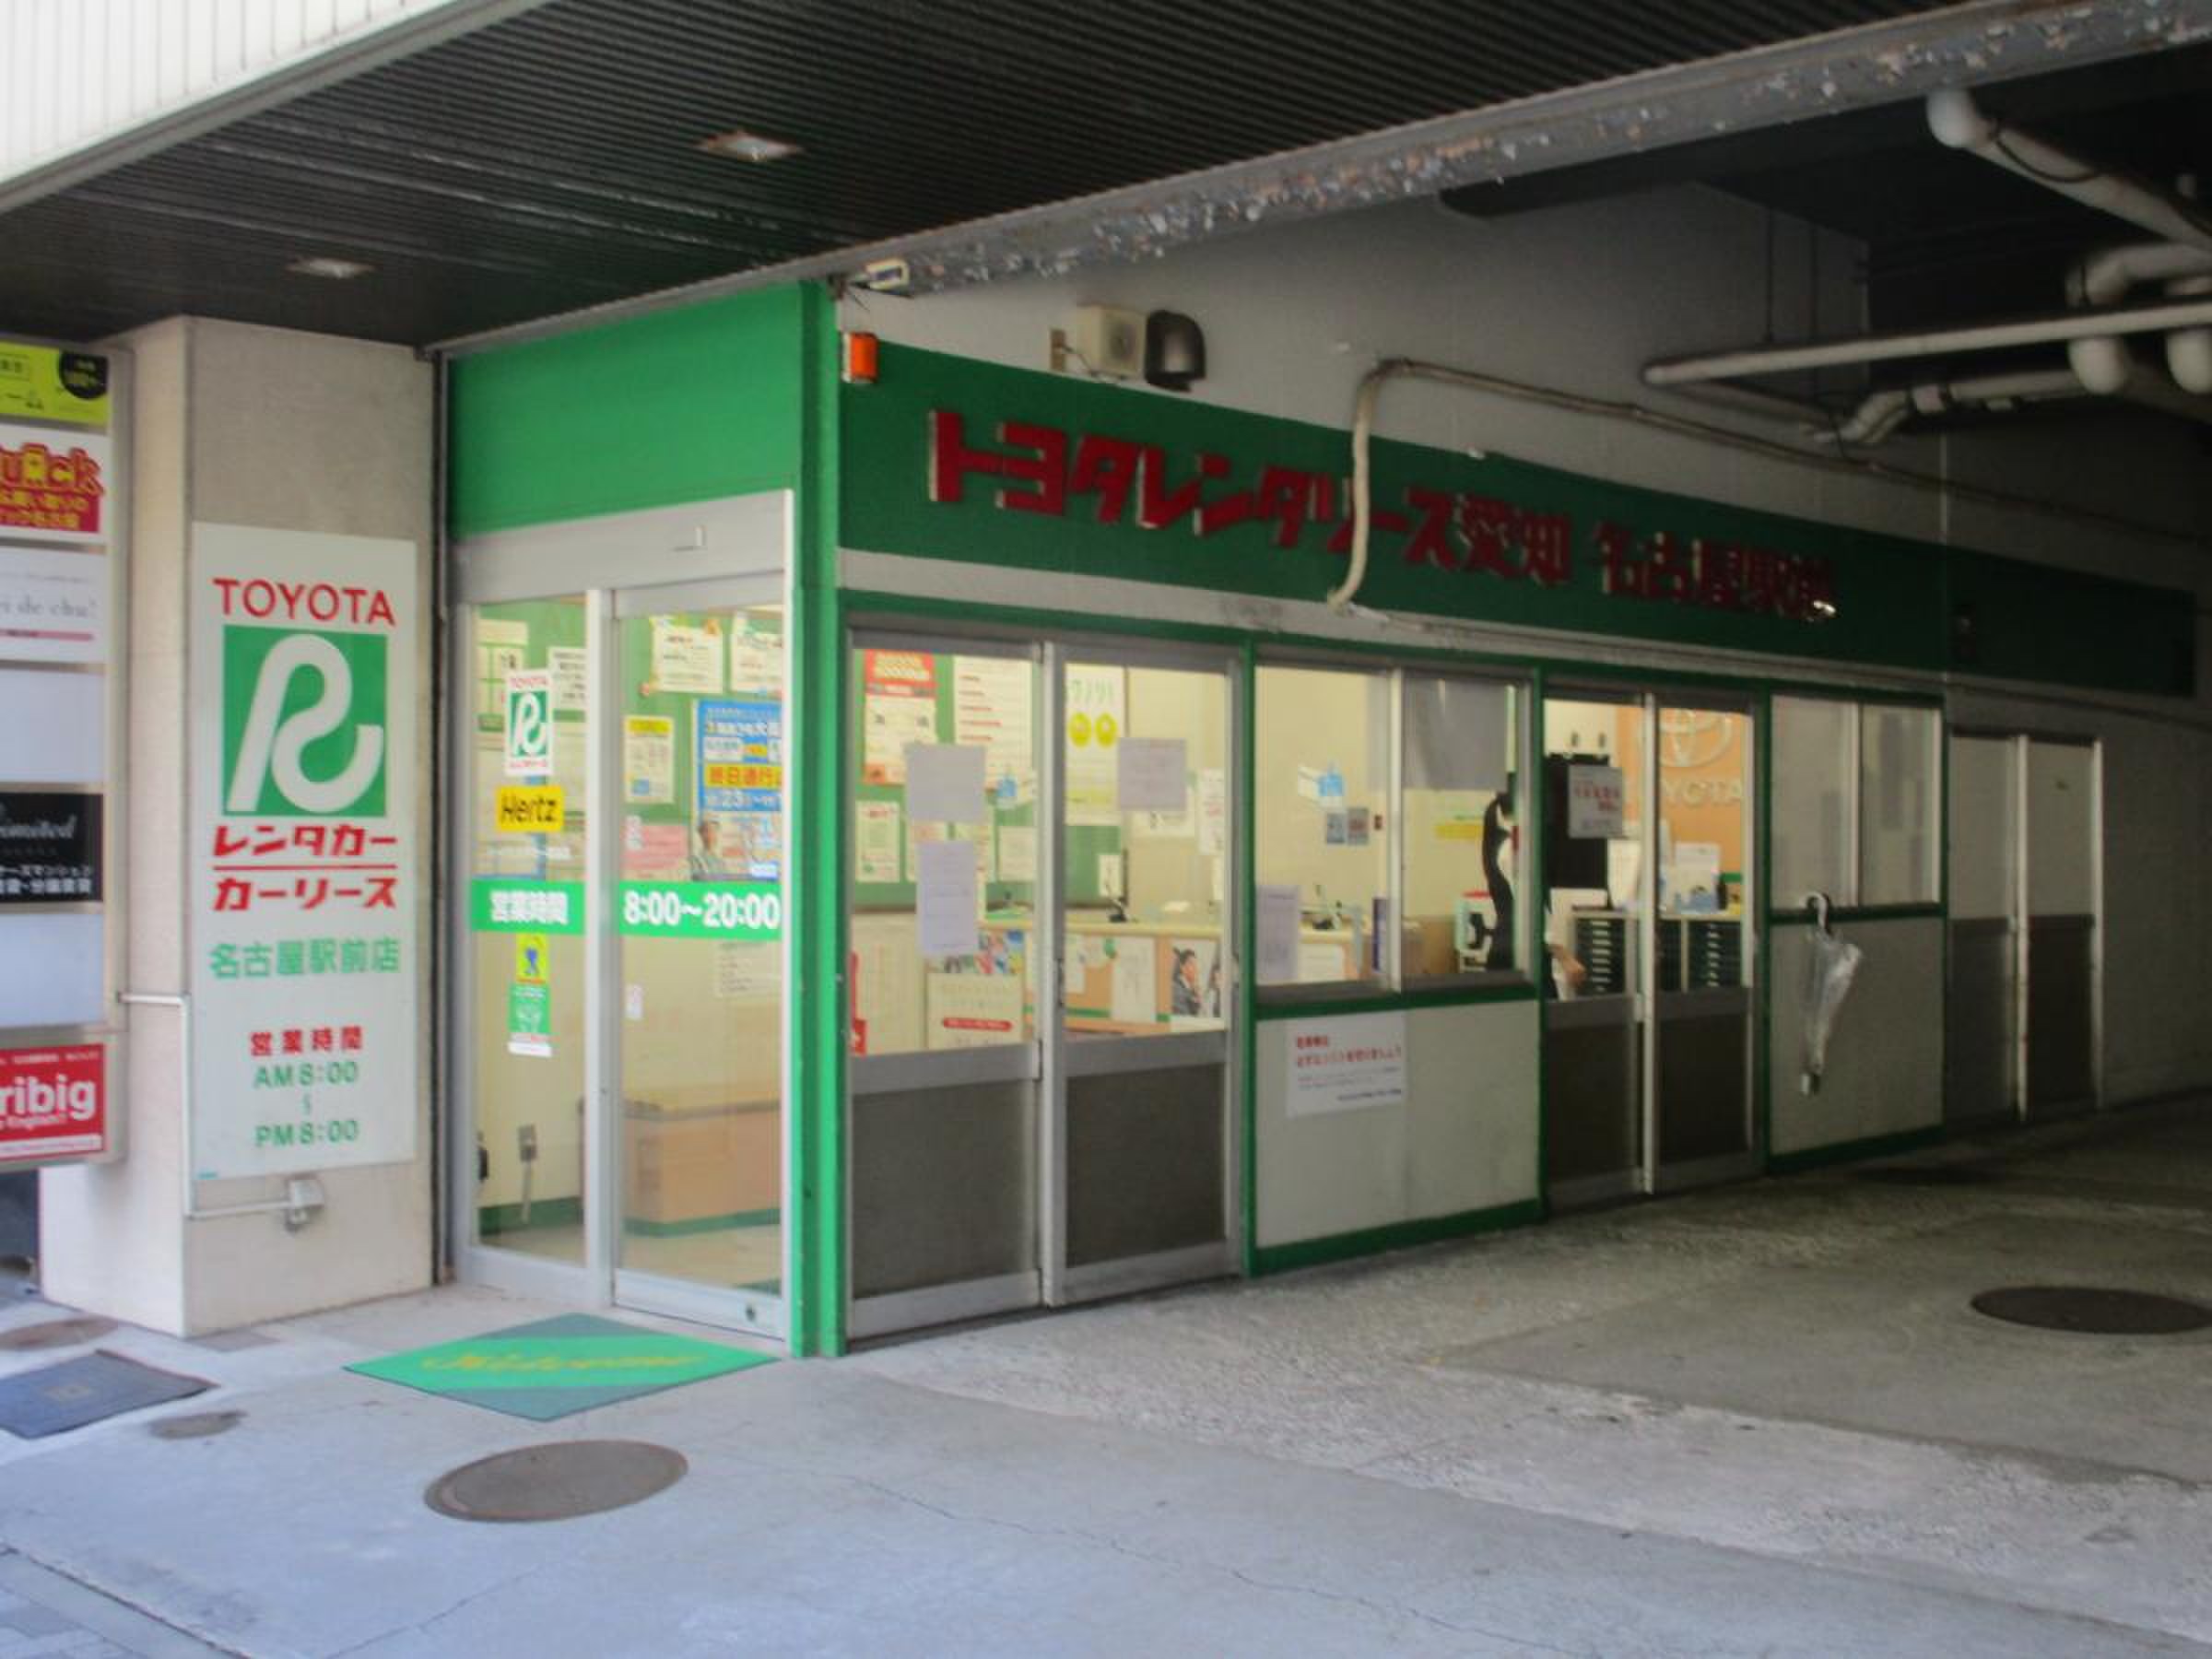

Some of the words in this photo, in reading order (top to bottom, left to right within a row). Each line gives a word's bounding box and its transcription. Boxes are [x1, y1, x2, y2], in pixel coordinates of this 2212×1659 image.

[213, 578, 396, 626] TOYOTA
[500, 797, 558, 825] Hertz
[214, 825, 397, 857] レンタカー
[214, 877, 397, 912] カーリース
[490, 891, 568, 924] 営業時間
[210, 936, 400, 980] 名古屋駅前店
[250, 1026, 363, 1057] 営業時間
